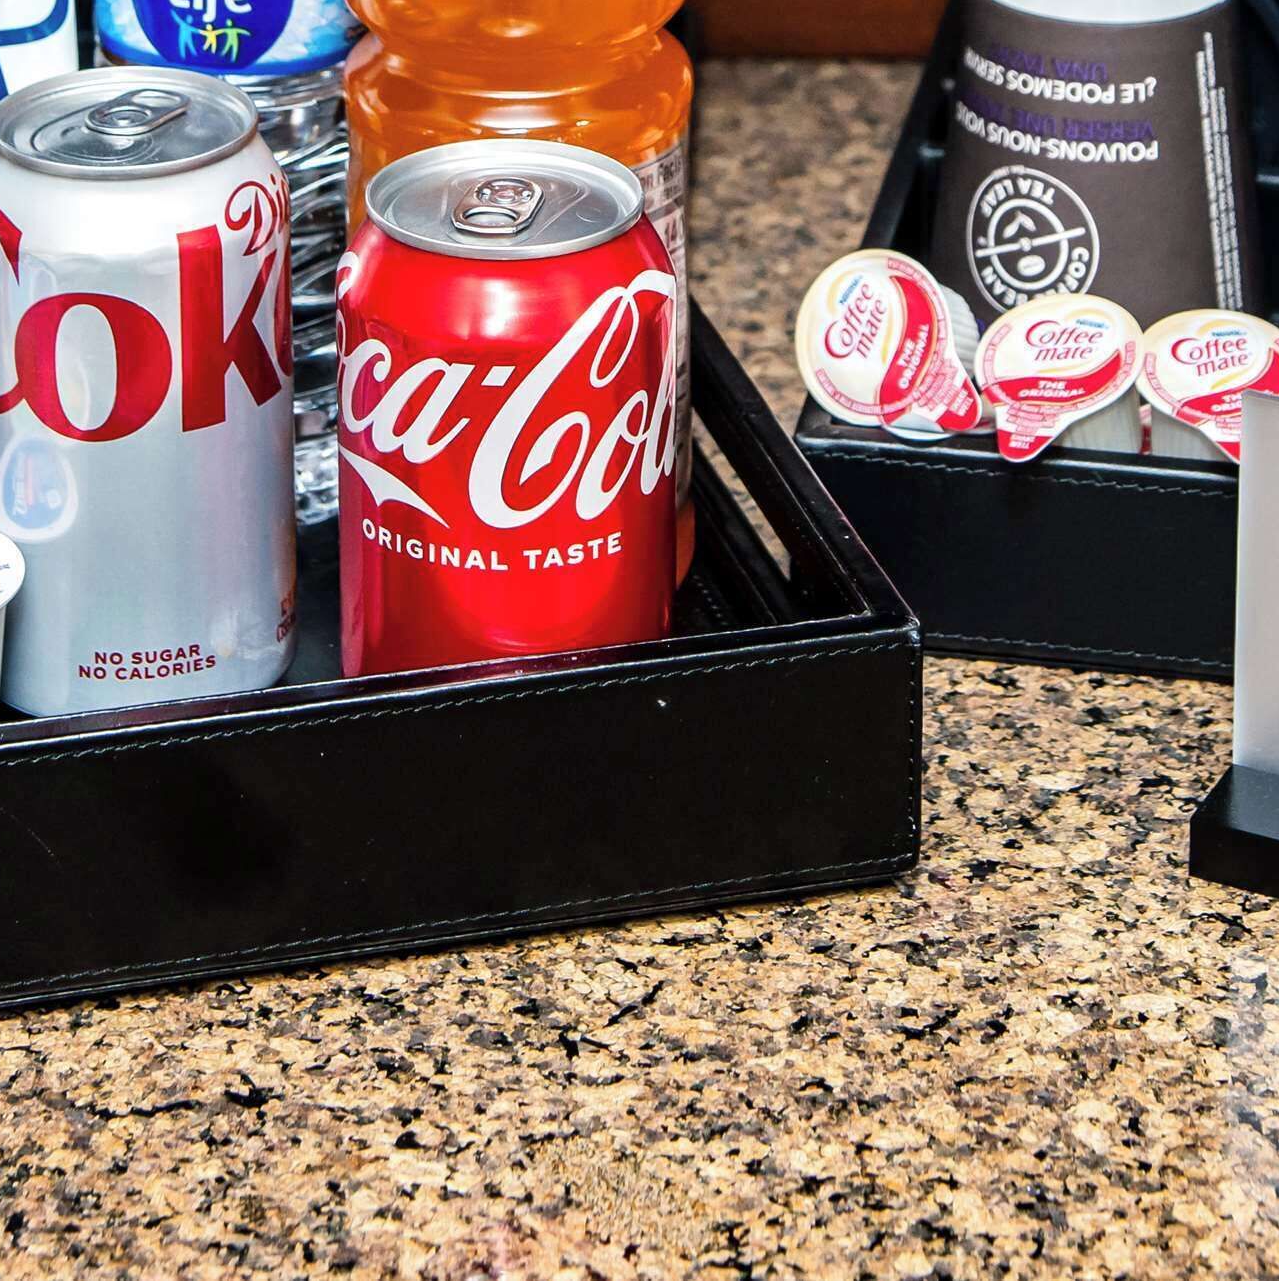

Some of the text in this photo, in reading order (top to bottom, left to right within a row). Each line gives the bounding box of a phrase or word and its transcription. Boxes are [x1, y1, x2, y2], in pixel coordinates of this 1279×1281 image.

[1052, 57, 1109, 81] UNA
[1006, 69, 1116, 105] PODEMOS
[986, 122, 1160, 163] POUVONS-NOUS
[1065, 118, 1154, 141] VERSER
[1015, 176, 1056, 206] TEA
[1034, 246, 1090, 300] COFF
[824, 282, 874, 359] Coffee
[856, 299, 887, 360] mate
[1025, 319, 1104, 348] Coffee
[897, 338, 916, 368] THE
[898, 323, 930, 389] ORIGINAL
[1034, 346, 1094, 362] mate
[1170, 337, 1248, 366] Coffee
[1196, 353, 1250, 377] mate
[335, 249, 677, 531] ca-Col
[1017, 387, 1087, 399] ORIGINAL
[1038, 380, 1068, 389] THE
[361, 517, 623, 572] ORIGINAL TASTE
[77, 654, 218, 681] NO CALORIES
[94, 643, 201, 666] NO SUGAR
